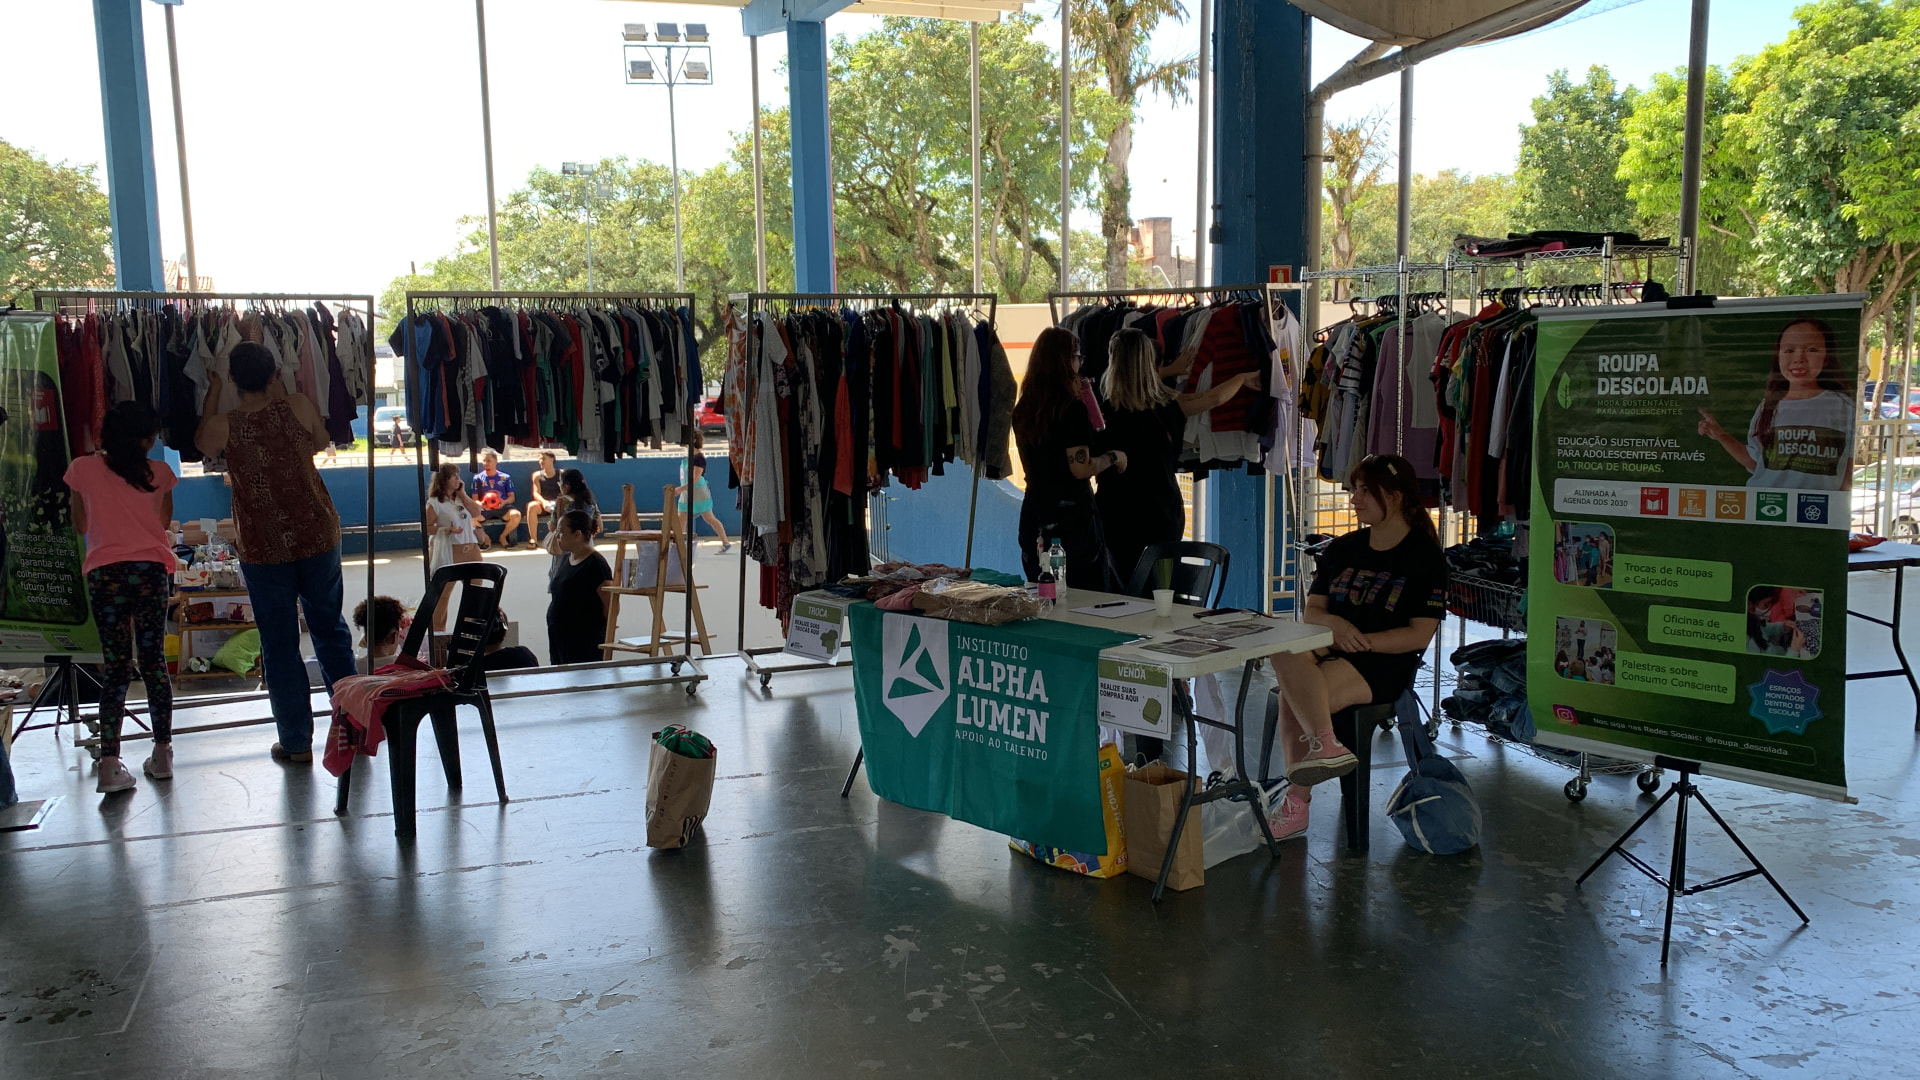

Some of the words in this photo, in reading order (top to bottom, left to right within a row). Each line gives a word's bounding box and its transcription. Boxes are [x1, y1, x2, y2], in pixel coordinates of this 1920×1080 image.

[1598, 354, 1659, 373] ROUPA
[1597, 376, 1709, 395] DESCOLADA
[1622, 399, 1680, 407] SUSTENTÁVEL
[1620, 408, 1682, 416] ADOLESCENTES
[1778, 429, 1816, 441] ROUPA
[1558, 436, 1608, 447] EDUCAÇÃO
[1610, 437, 1680, 448] SUSTENTÁVEL
[1558, 449, 1580, 457] PARA
[1583, 450, 1657, 460] ADOLESCENTES
[1660, 450, 1706, 461] ATRAVÉS
[1557, 460, 1570, 469] DA
[1573, 462, 1603, 471] TROCA
[1606, 462, 1620, 471] DE
[1623, 463, 1665, 473] ROUPAS.
[15, 531, 41, 542] Semear
[20, 558, 52, 568] garantia
[55, 560, 64, 568] de
[16, 570, 57, 580] colhermos
[1624, 563, 1656, 573] Trocas
[1660, 565, 1672, 574] de
[1677, 567, 1712, 578] Roupas
[21, 581, 44, 592] futuro
[46, 582, 65, 593] fértil
[1634, 576, 1678, 587] Calçados
[27, 595, 71, 606] consciente.
[808, 606, 828, 618] TROCA
[1663, 614, 1704, 626] Oficinas
[1707, 619, 1720, 628] de
[1663, 626, 1735, 642] Customização
[956, 636, 1028, 660] INSTITUTO
[1118, 666, 1146, 680] VENDA
[1622, 660, 1666, 673] Palestras
[1670, 667, 1698, 677] sobre
[958, 656, 1049, 703] ALPHA
[1622, 672, 1667, 685] Consumo
[1671, 678, 1728, 693] Consciente
[1100, 683, 1120, 692] REALIZE
[1122, 686, 1136, 694] SUAS
[1769, 684, 1801, 694] ESPAÇOS
[1100, 690, 1124, 700] COMPRAS
[1765, 692, 1805, 702] MONTADOS
[1764, 700, 1793, 708] DENTRO
[956, 693, 1049, 744] LUMEN
[1768, 708, 1800, 718] ESCOLAS
[1593, 718, 1608, 726] Nos
[1610, 721, 1626, 729] siga
[1644, 725, 1668, 736] Redes
[1670, 730, 1702, 742] Sociais:
[1705, 736, 1788, 756] @roupa_descolada
[955, 729, 984, 744] APOIO
[988, 737, 1000, 749] AO
[1004, 741, 1048, 761] TALENTO
